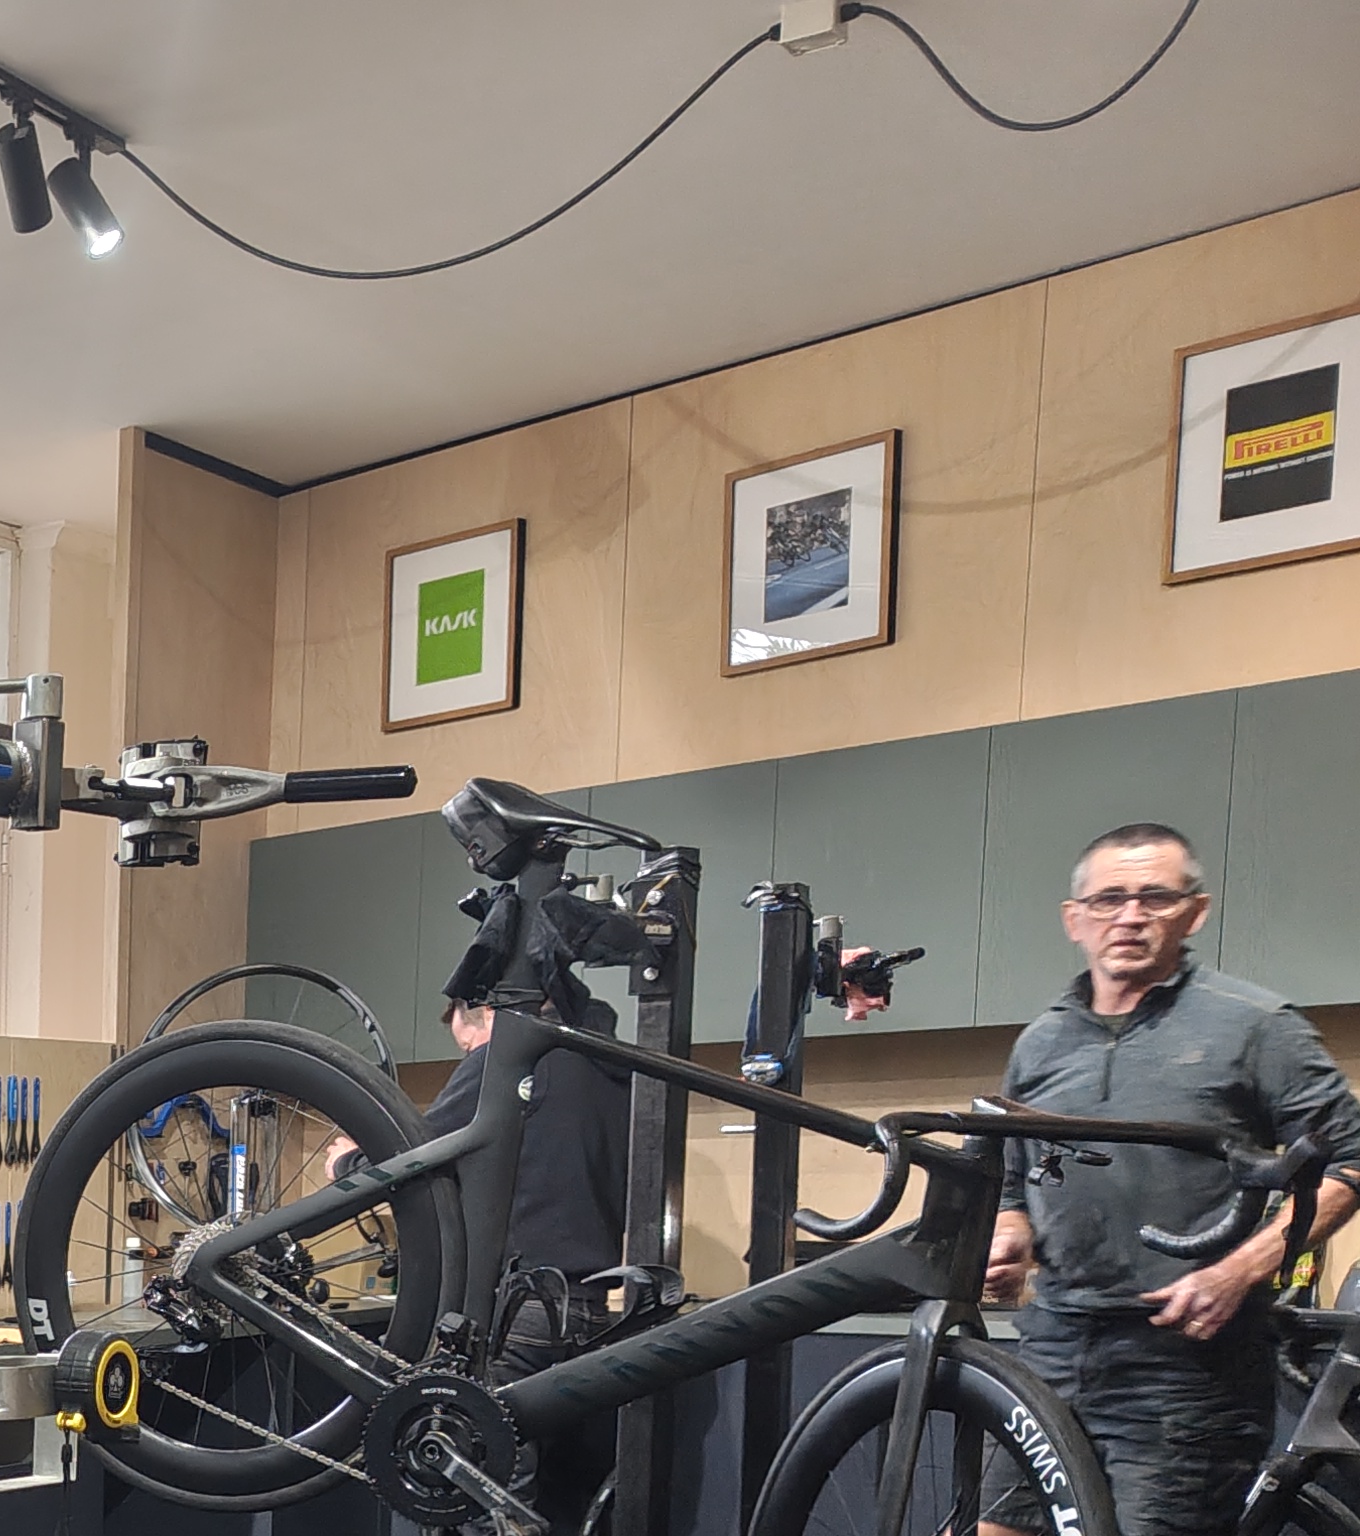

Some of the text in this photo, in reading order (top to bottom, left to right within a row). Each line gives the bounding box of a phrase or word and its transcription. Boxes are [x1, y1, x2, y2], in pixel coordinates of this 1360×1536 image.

[1233, 420, 1325, 460] PIRELLI
[425, 607, 478, 637] KASK
[27, 1297, 56, 1341] DT
[1003, 1405, 1067, 1495] SWISS
